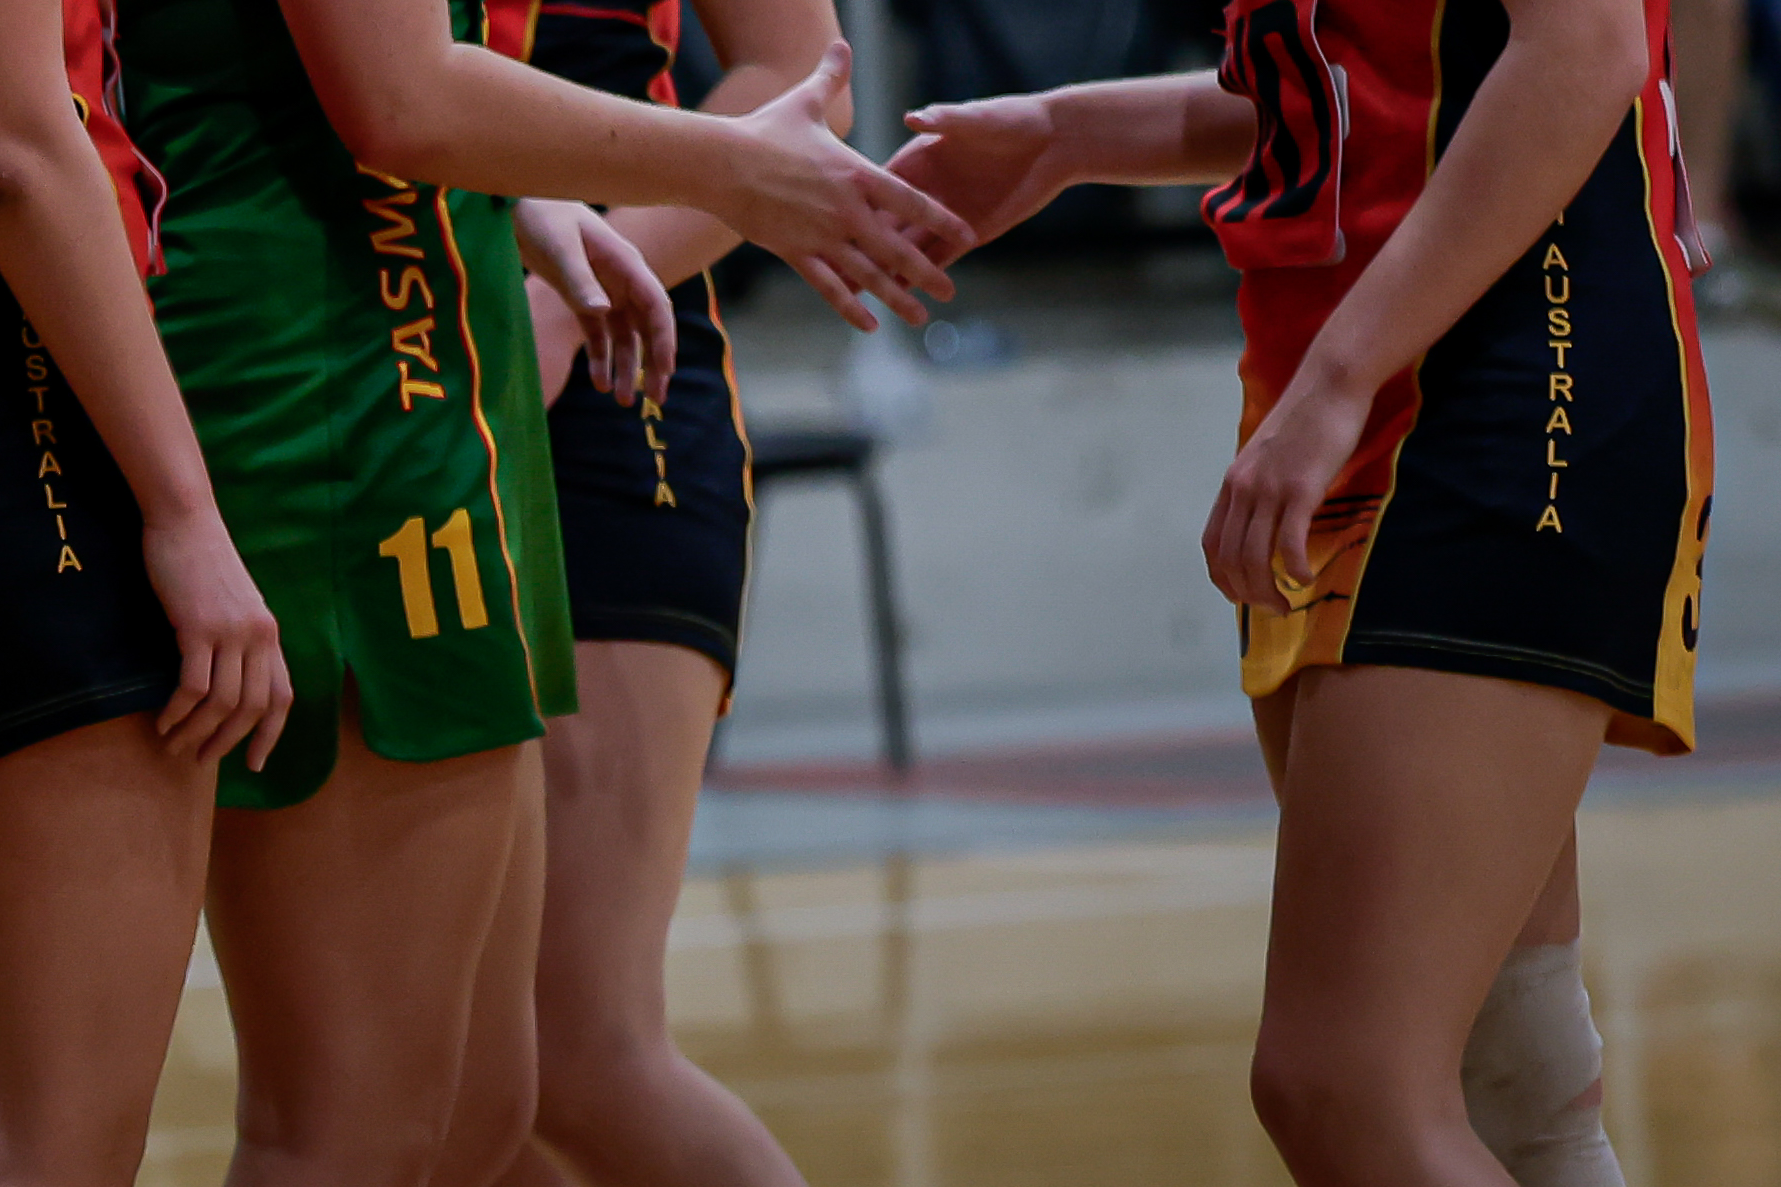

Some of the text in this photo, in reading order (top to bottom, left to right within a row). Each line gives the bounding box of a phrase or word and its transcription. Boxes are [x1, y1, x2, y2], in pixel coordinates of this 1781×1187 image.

[21, 313, 83, 574] USTRALIA
[1535, 242, 1573, 534] AUSTRALIA
[378, 507, 489, 640] 11
